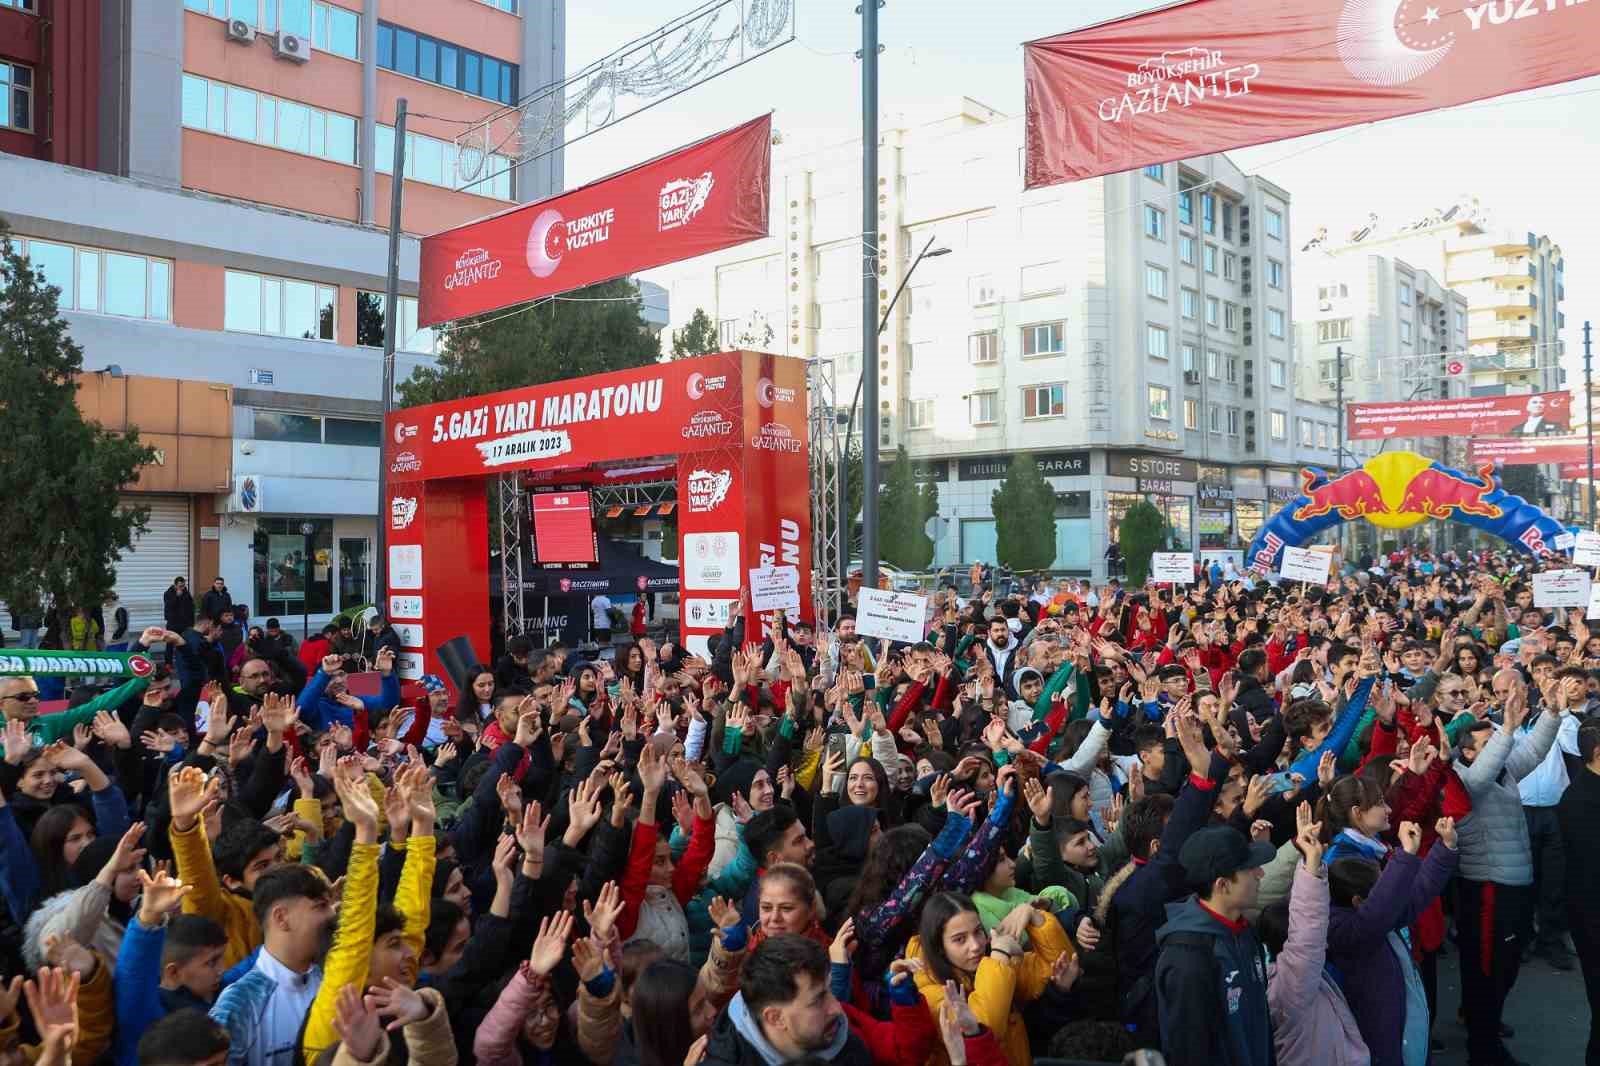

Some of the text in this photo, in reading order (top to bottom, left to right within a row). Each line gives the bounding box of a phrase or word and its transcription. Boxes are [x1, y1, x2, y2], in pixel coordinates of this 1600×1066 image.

[494, 400, 536, 434] YARI
[541, 378, 663, 428] MARATONU
[492, 436, 562, 459] 17 ARALIK 2023
[1037, 458, 1082, 472] SARAR
[1139, 479, 1171, 491] SARAR
[27, 656, 124, 674] MARATON
